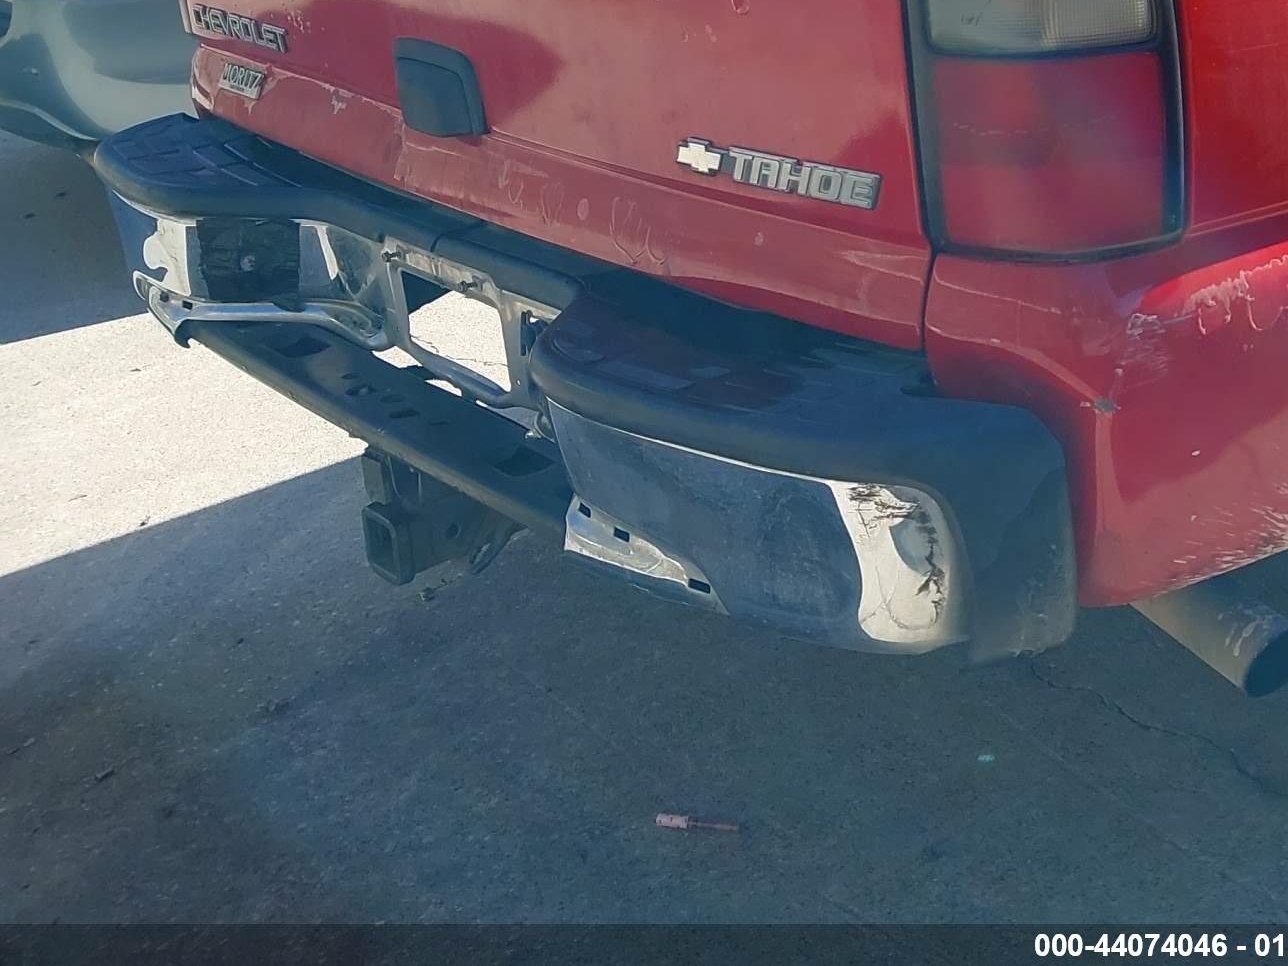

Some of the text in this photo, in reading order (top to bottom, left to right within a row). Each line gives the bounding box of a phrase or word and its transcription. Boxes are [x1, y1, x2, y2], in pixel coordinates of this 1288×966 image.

[192, 3, 287, 53] CHEVROLET
[222, 63, 264, 89] MORITZ
[729, 147, 881, 210] TAHOE
